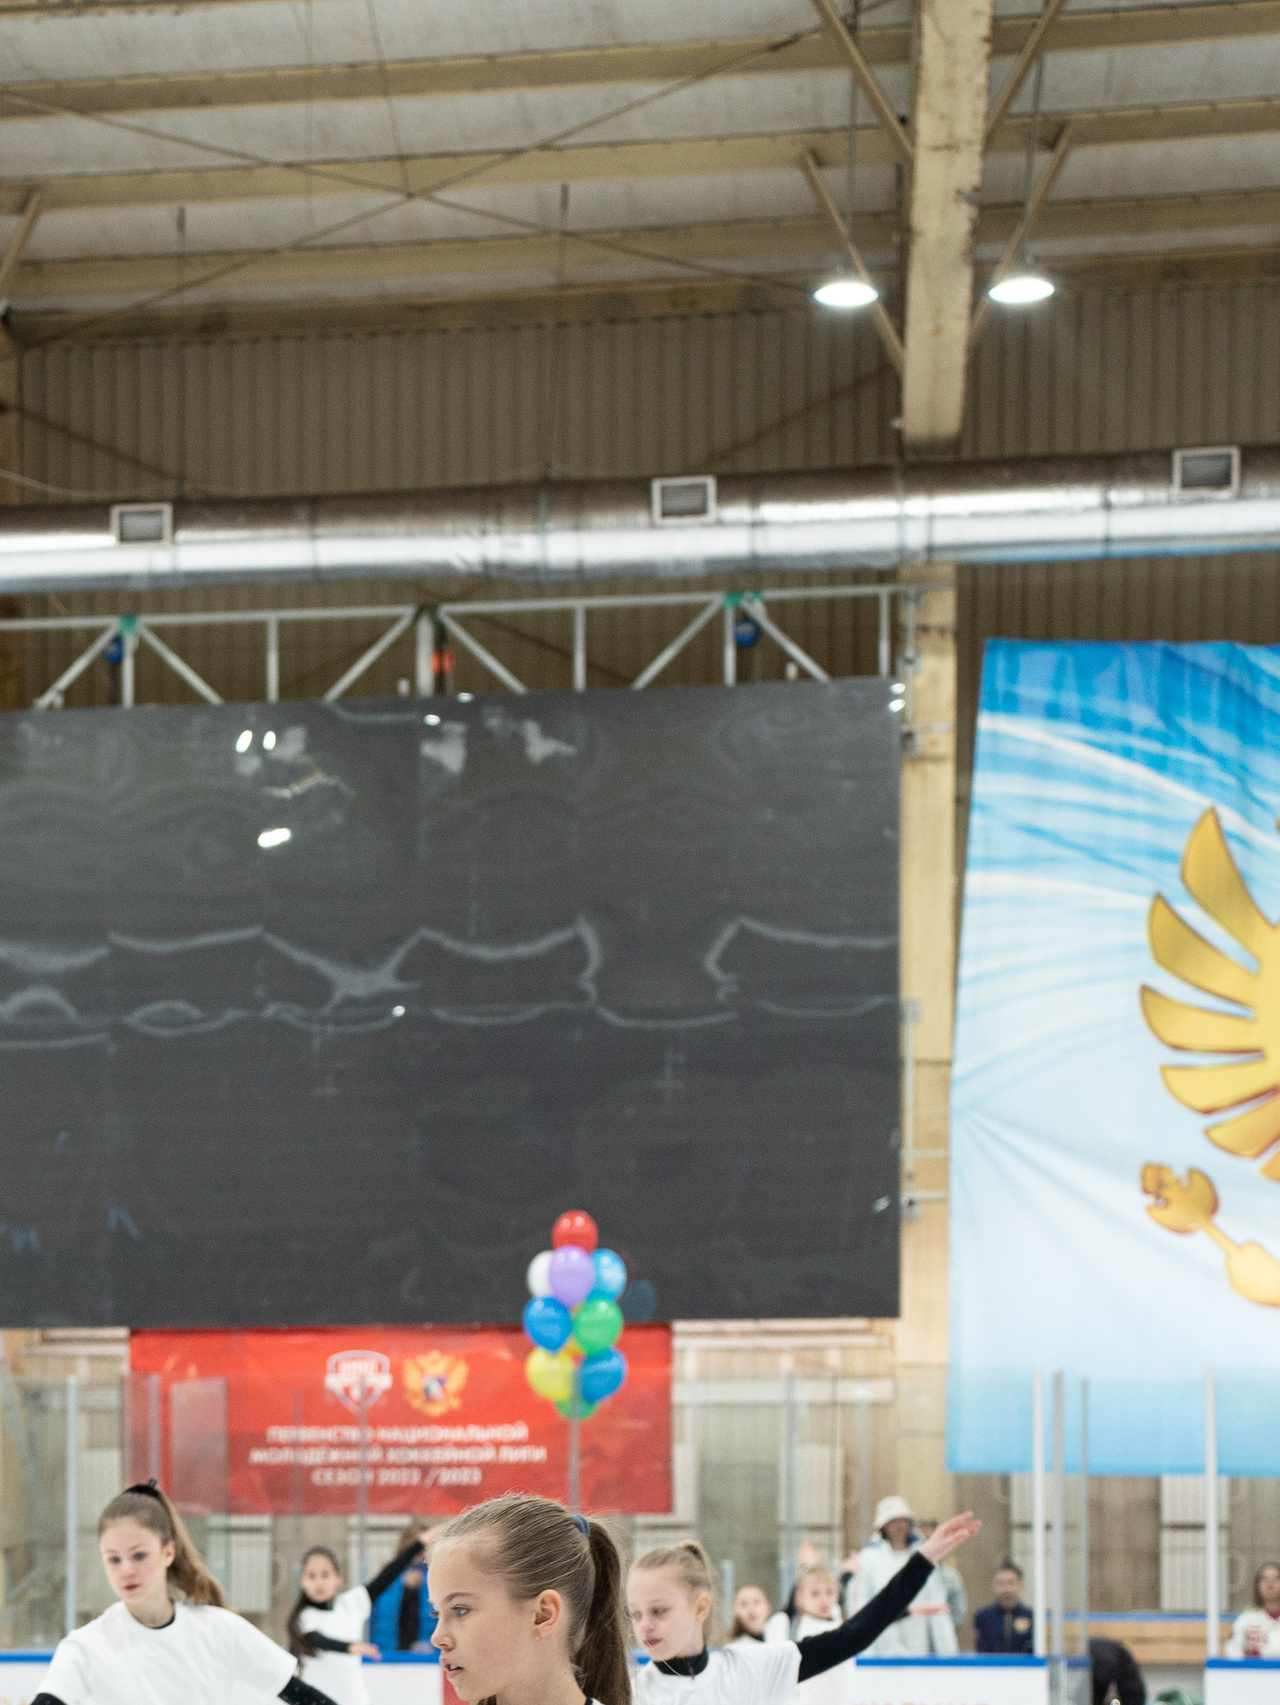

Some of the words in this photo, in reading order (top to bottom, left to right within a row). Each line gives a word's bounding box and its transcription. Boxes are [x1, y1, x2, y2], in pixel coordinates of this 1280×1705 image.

[376, 1421, 528, 1443] НАЦИОНАЛЬНОЙ
[386, 1444, 496, 1465] ХОККЕЙНОЙ
[497, 1446, 547, 1463] ЛИГИ
